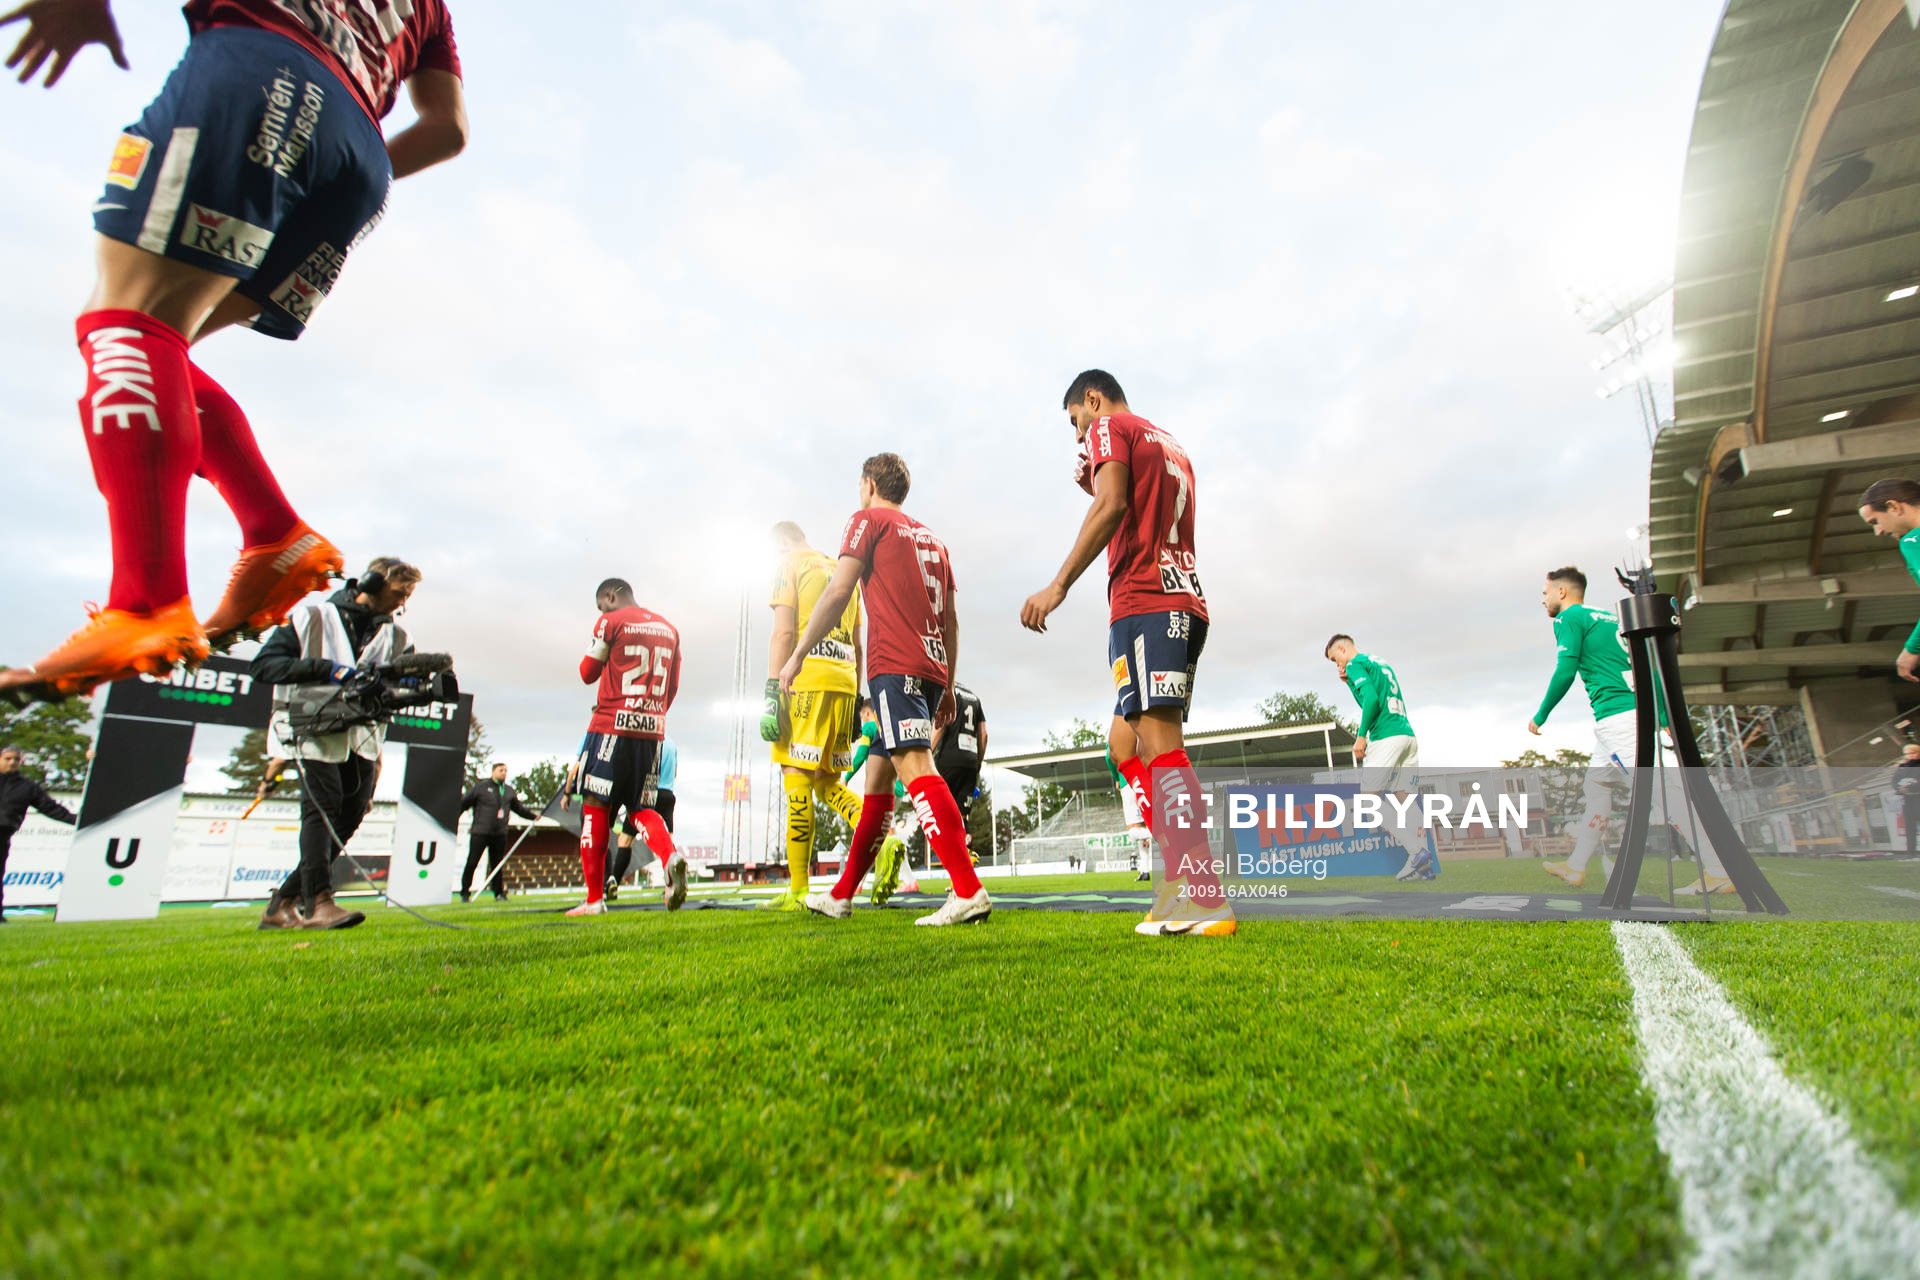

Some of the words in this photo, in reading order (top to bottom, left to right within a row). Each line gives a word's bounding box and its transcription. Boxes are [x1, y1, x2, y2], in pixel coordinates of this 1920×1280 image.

[88, 326, 163, 435] MIKE
[1164, 458, 1188, 544] 7
[916, 549, 944, 615] 5
[139, 660, 254, 695] NIBET
[621, 645, 673, 697] 25
[1381, 667, 1399, 695] 3
[624, 698, 664, 713] RAZAK
[964, 704, 975, 731] 1
[616, 712, 656, 732] BESAB
[789, 794, 810, 842] MIKE
[105, 838, 141, 869] U
[415, 841, 437, 865] U
[1300, 841, 1346, 859] MUSIK
[1347, 837, 1381, 853] JUST
[3, 871, 64, 890] emax
